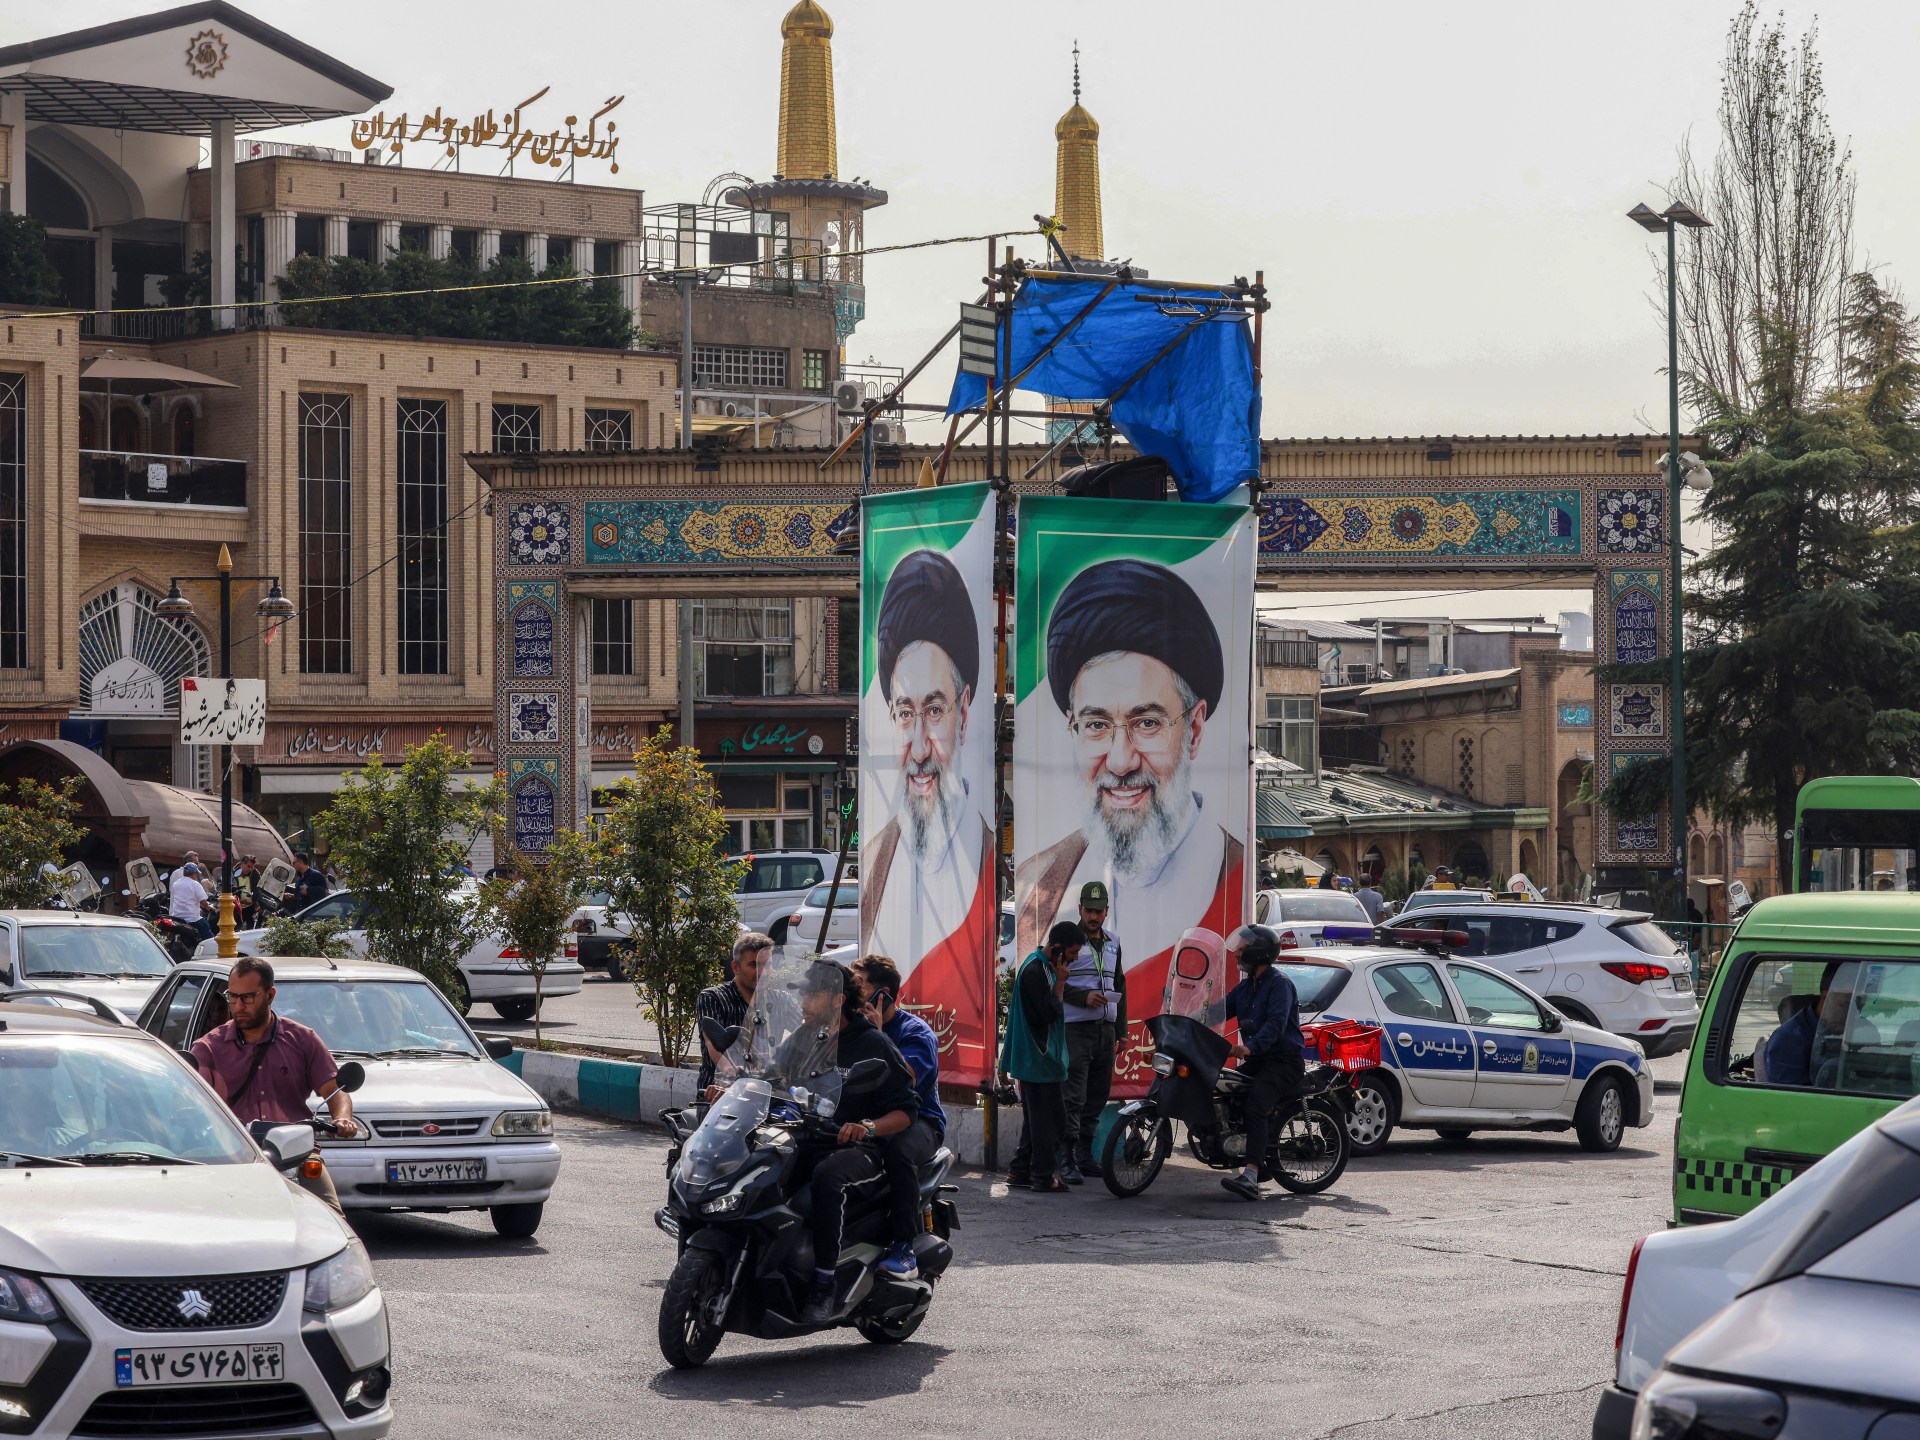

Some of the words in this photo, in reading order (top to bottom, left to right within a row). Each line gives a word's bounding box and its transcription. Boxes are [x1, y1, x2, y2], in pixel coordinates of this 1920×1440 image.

[351, 111, 407, 153] ایران
[410, 106, 458, 157] جواهر
[472, 109, 498, 147] طلا
[499, 86, 550, 160] مرکز
[573, 95, 625, 174] بزرگ
[182, 698, 208, 741] شهید
[322, 734, 357, 752] ساعت
[357, 727, 389, 757] گالری
[742, 724, 786, 751] مهدی
[780, 728, 808, 753] سید
[1413, 1037, 1468, 1062] پلیس
[252, 1353, 281, 1378] ۴۴
